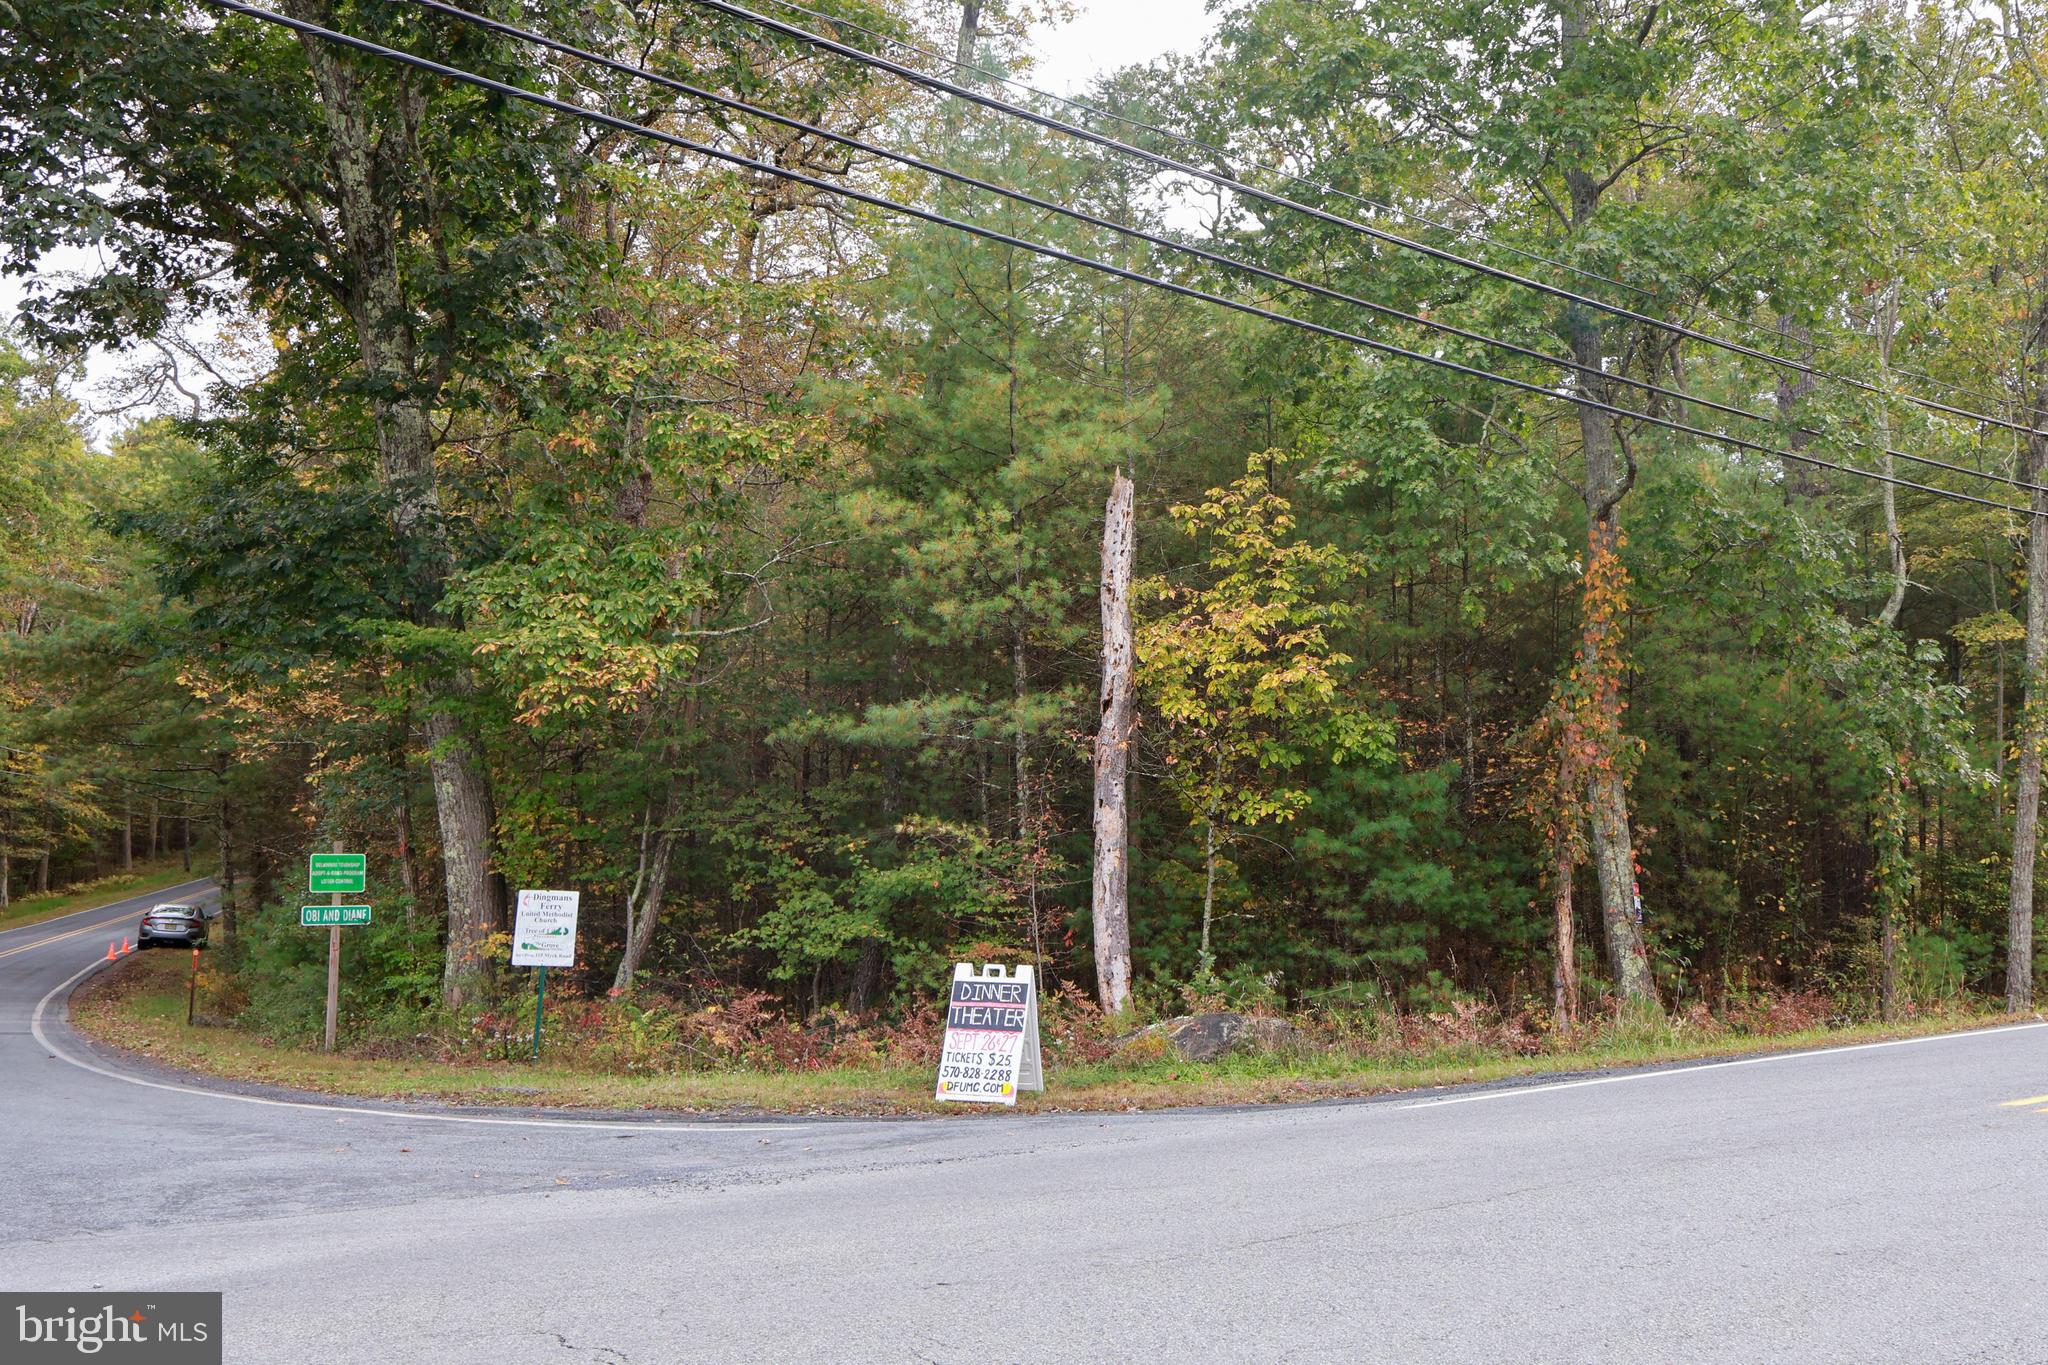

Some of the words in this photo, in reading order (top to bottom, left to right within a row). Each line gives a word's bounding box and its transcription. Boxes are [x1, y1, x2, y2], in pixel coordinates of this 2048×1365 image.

[533, 893, 573, 901] Dingmans
[540, 902, 562, 911] Ferry
[305, 910, 320, 922] OBI
[323, 910, 340, 922] AND
[960, 983, 1021, 1003] DINNER
[952, 1006, 1025, 1027] THEATER
[949, 1032, 980, 1050] SEPT
[946, 1052, 984, 1065] TICKETS
[988, 1053, 1012, 1066] $25
[942, 1066, 1012, 1082] 570-828-2288
[946, 1081, 1004, 1093] DFUMC.COM
